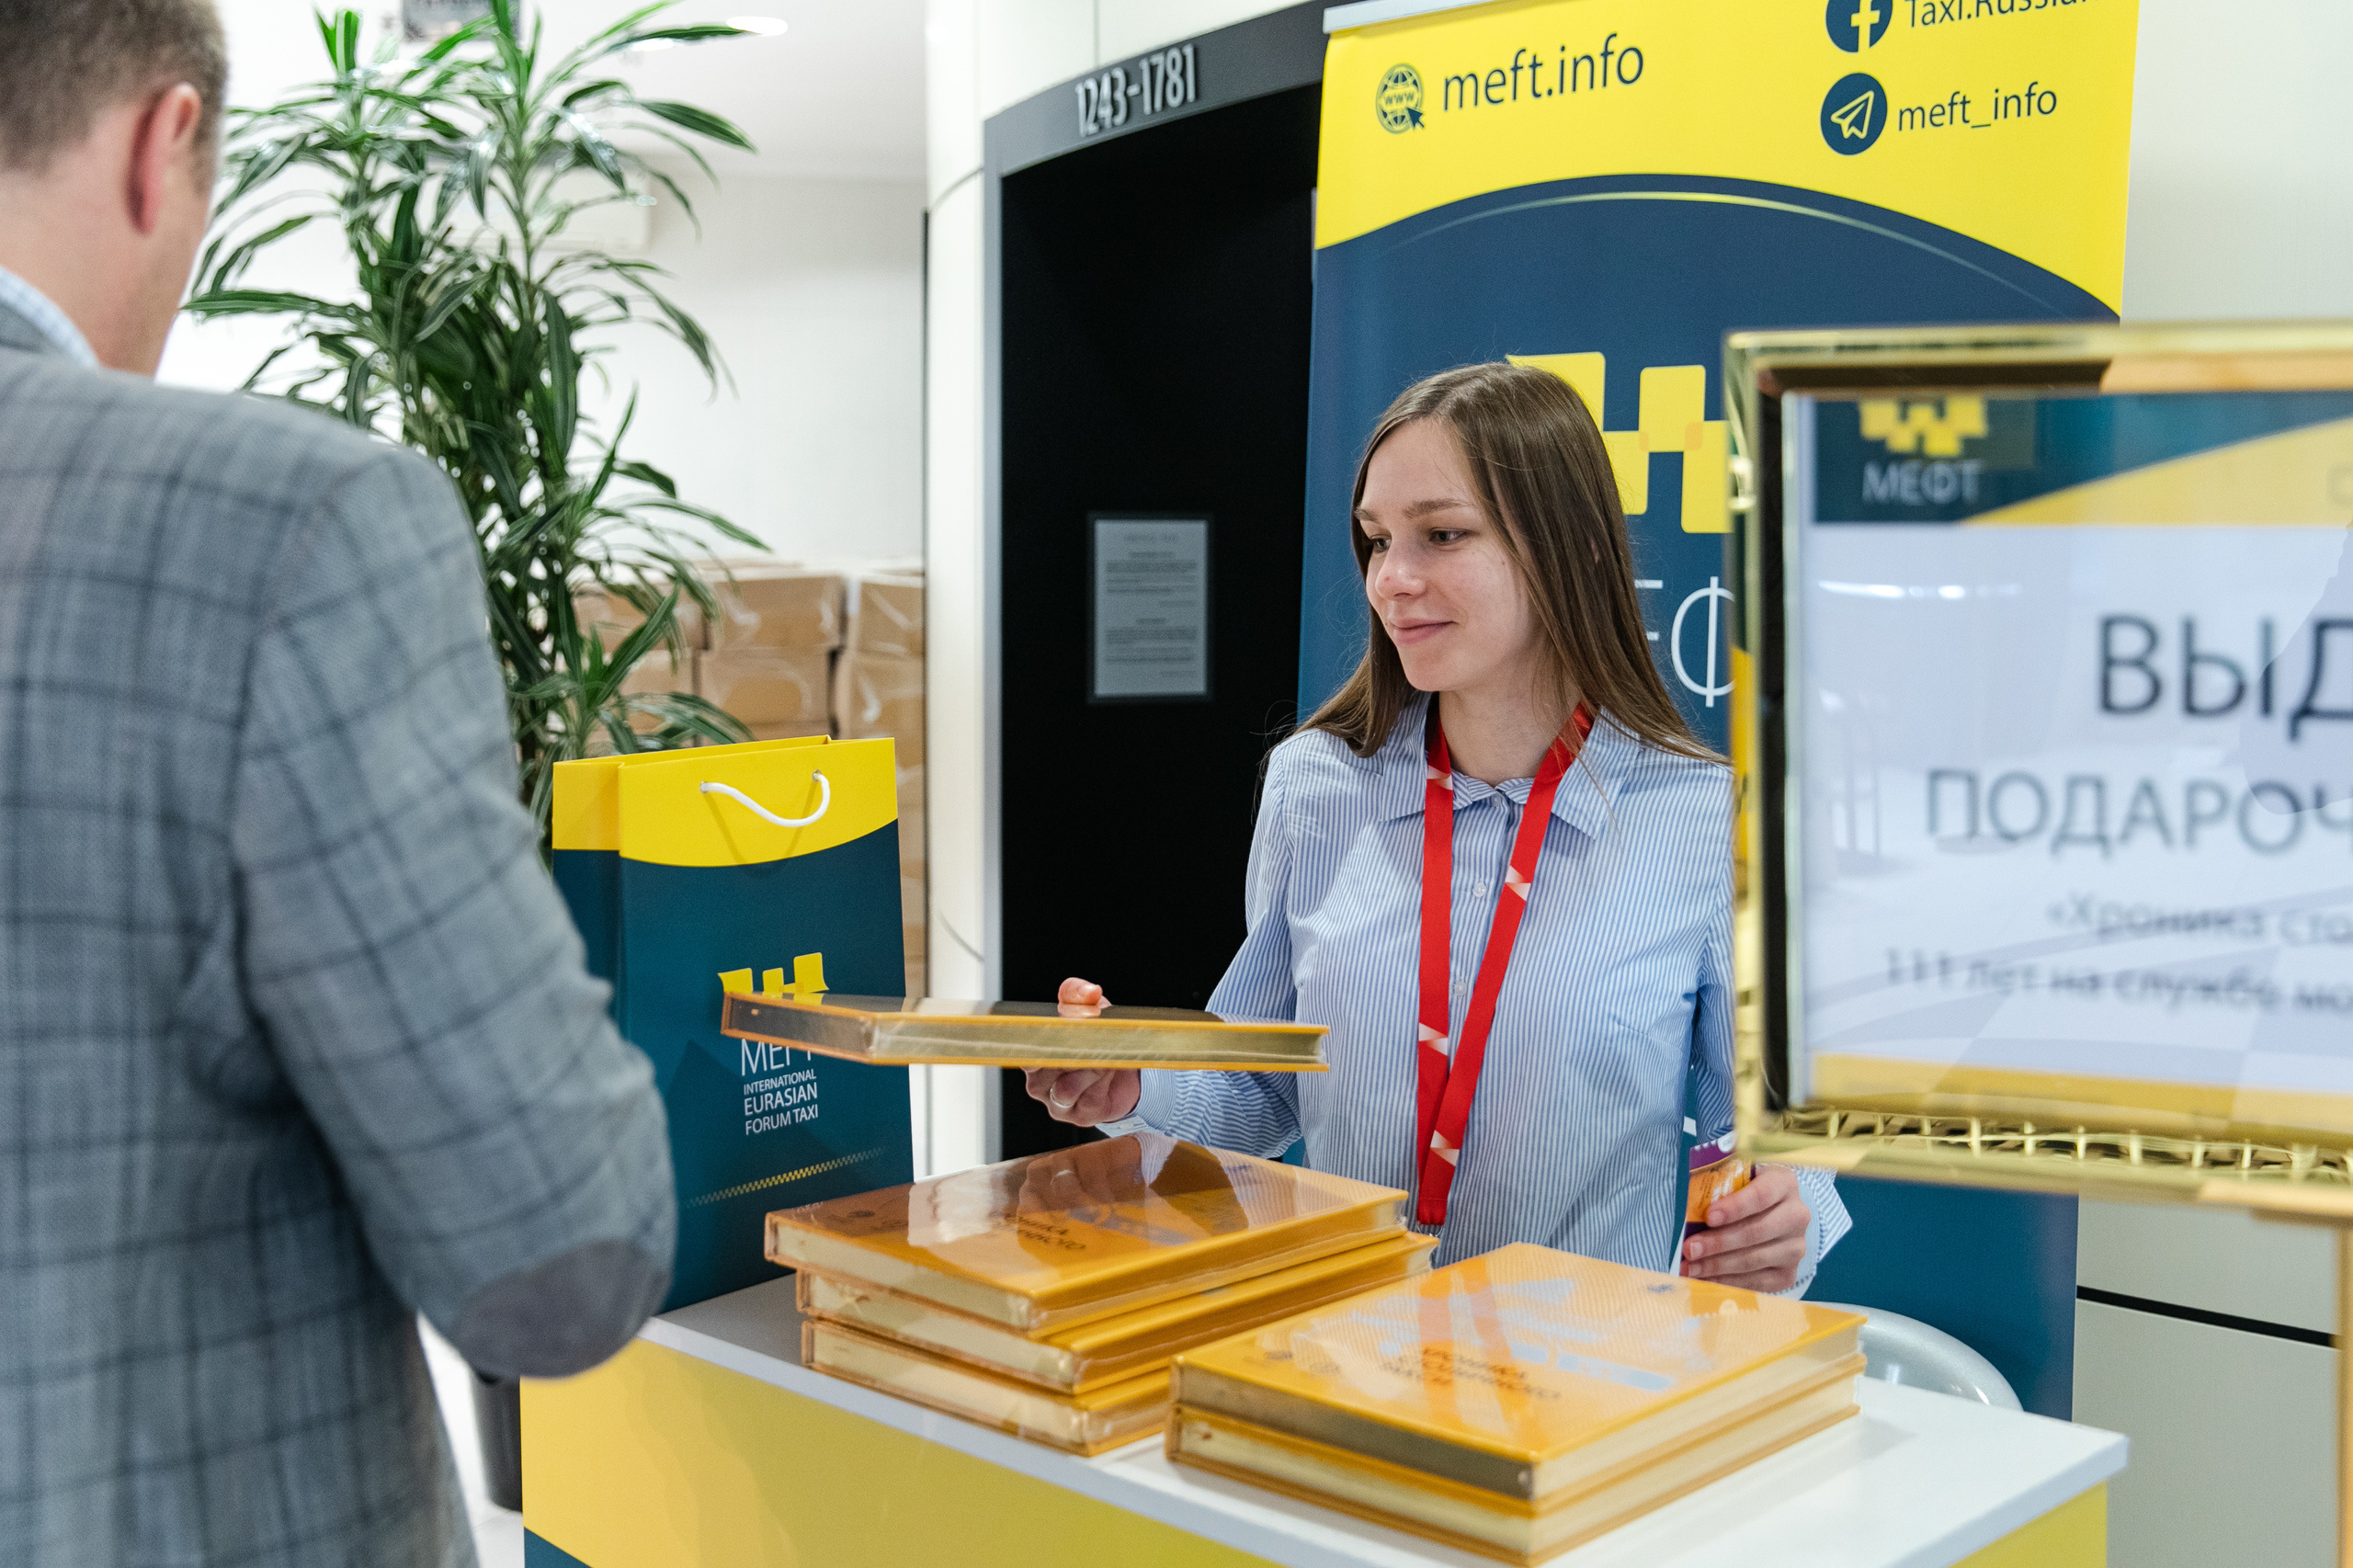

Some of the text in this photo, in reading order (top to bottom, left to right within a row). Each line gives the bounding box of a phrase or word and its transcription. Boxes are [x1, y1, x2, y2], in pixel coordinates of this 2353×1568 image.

[1075, 42, 1197, 137] 1243-1781
[1443, 32, 1643, 112] meft.info
[1898, 82, 2057, 131] meft_info
[1861, 460, 1981, 506] МЕФТ
[744, 1068, 817, 1096] INTERNATIONAL
[744, 1081, 818, 1117] EURASIAN
[745, 1103, 819, 1136] FORUM TAXI
